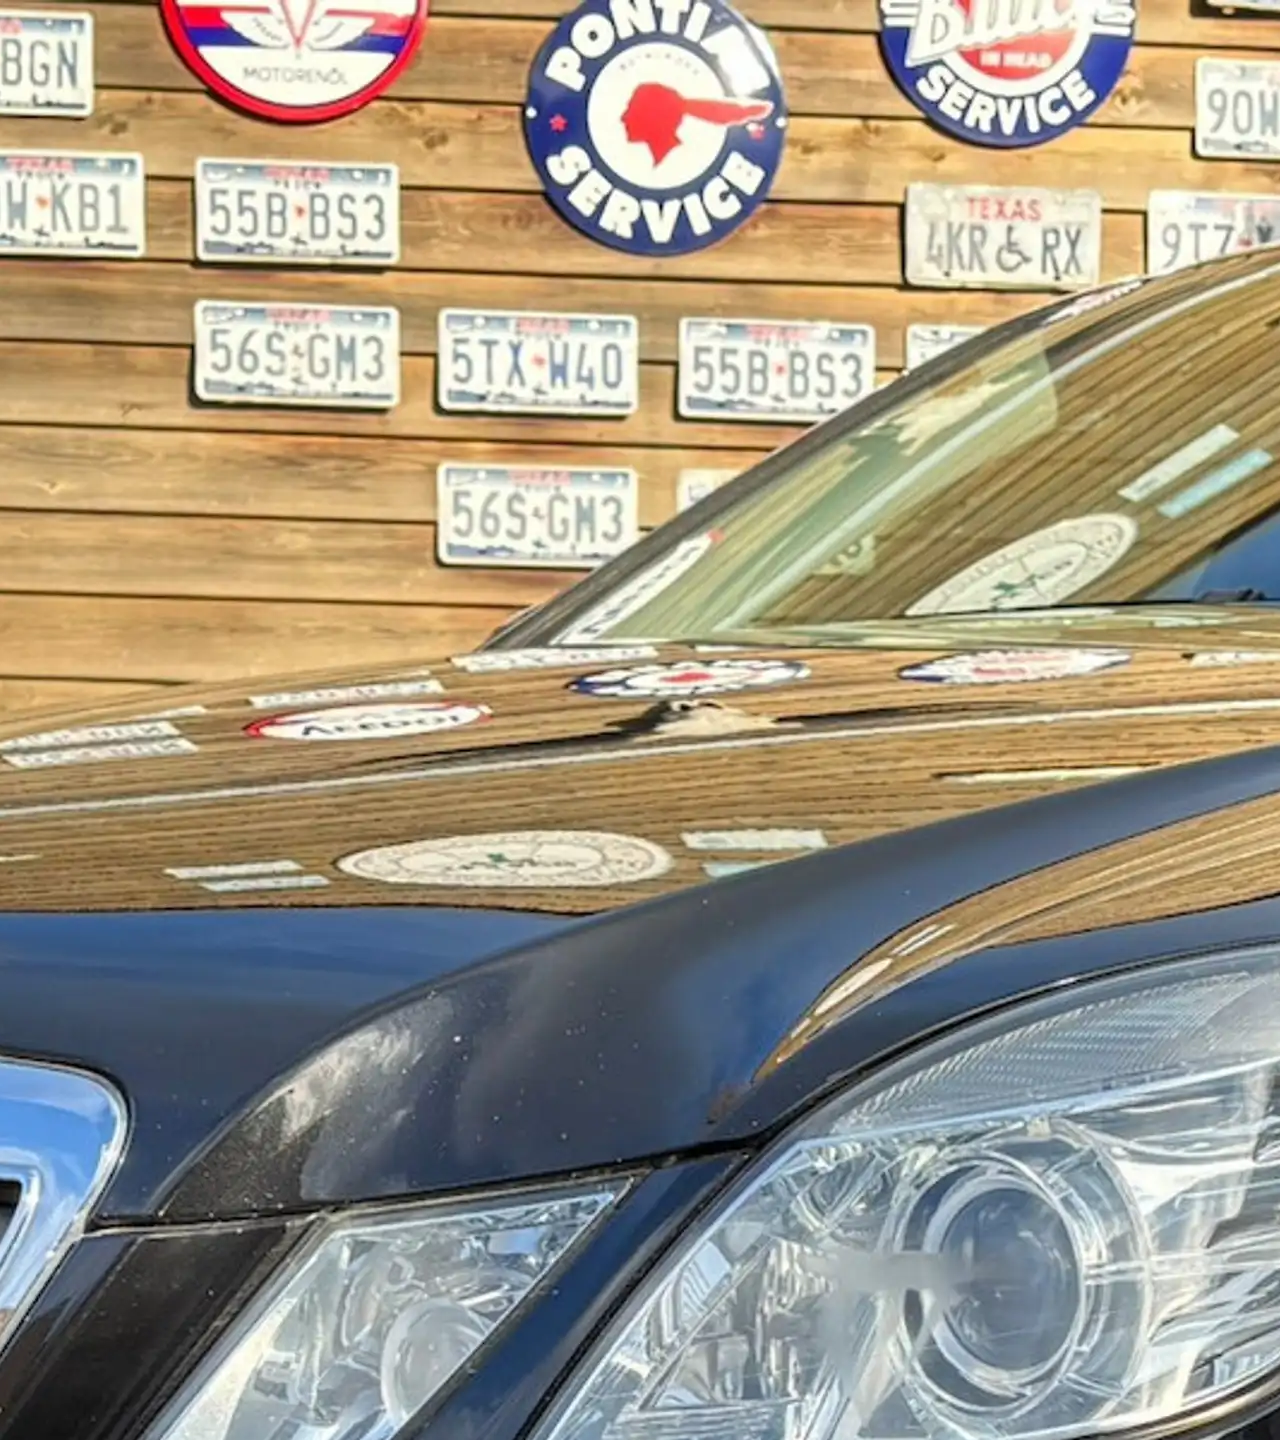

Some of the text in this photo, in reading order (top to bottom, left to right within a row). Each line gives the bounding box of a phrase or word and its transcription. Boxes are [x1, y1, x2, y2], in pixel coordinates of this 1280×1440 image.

[1, 37, 79, 89] BGN
[915, 63, 1096, 136] SERVICE
[50, 181, 129, 234] KB1
[209, 188, 387, 241] 55B BS3
[544, 145, 766, 244] SERVICE
[967, 195, 1043, 222] TEXAS
[924, 220, 1083, 276] 4KR RX
[209, 328, 385, 382] 56S GM3
[452, 337, 623, 391] 5TX W40
[693, 345, 863, 399] 55B BS3
[452, 489, 624, 543] 56S GM3
